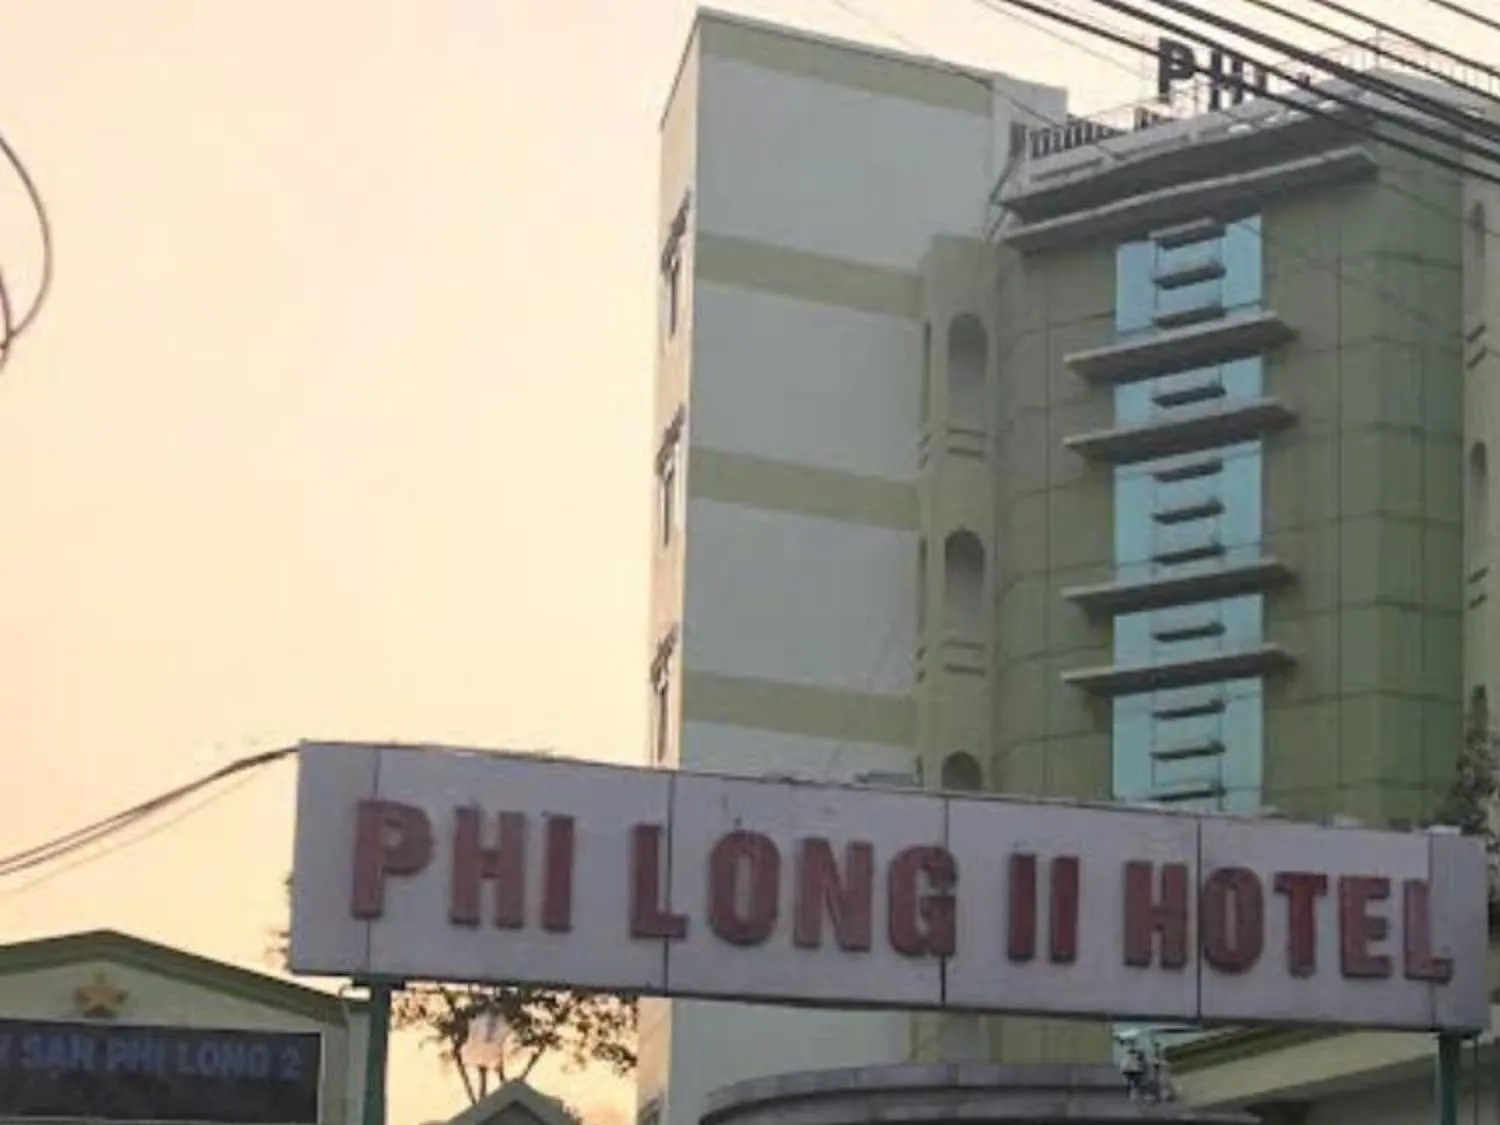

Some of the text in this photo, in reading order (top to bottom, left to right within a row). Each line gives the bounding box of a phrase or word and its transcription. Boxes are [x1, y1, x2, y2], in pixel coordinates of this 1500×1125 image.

[350, 799, 575, 934] PHI
[630, 823, 957, 958] LONG
[1122, 859, 1454, 983] HOTEL
[106, 1040, 166, 1076] PHI
[279, 1048, 301, 1080] 2
